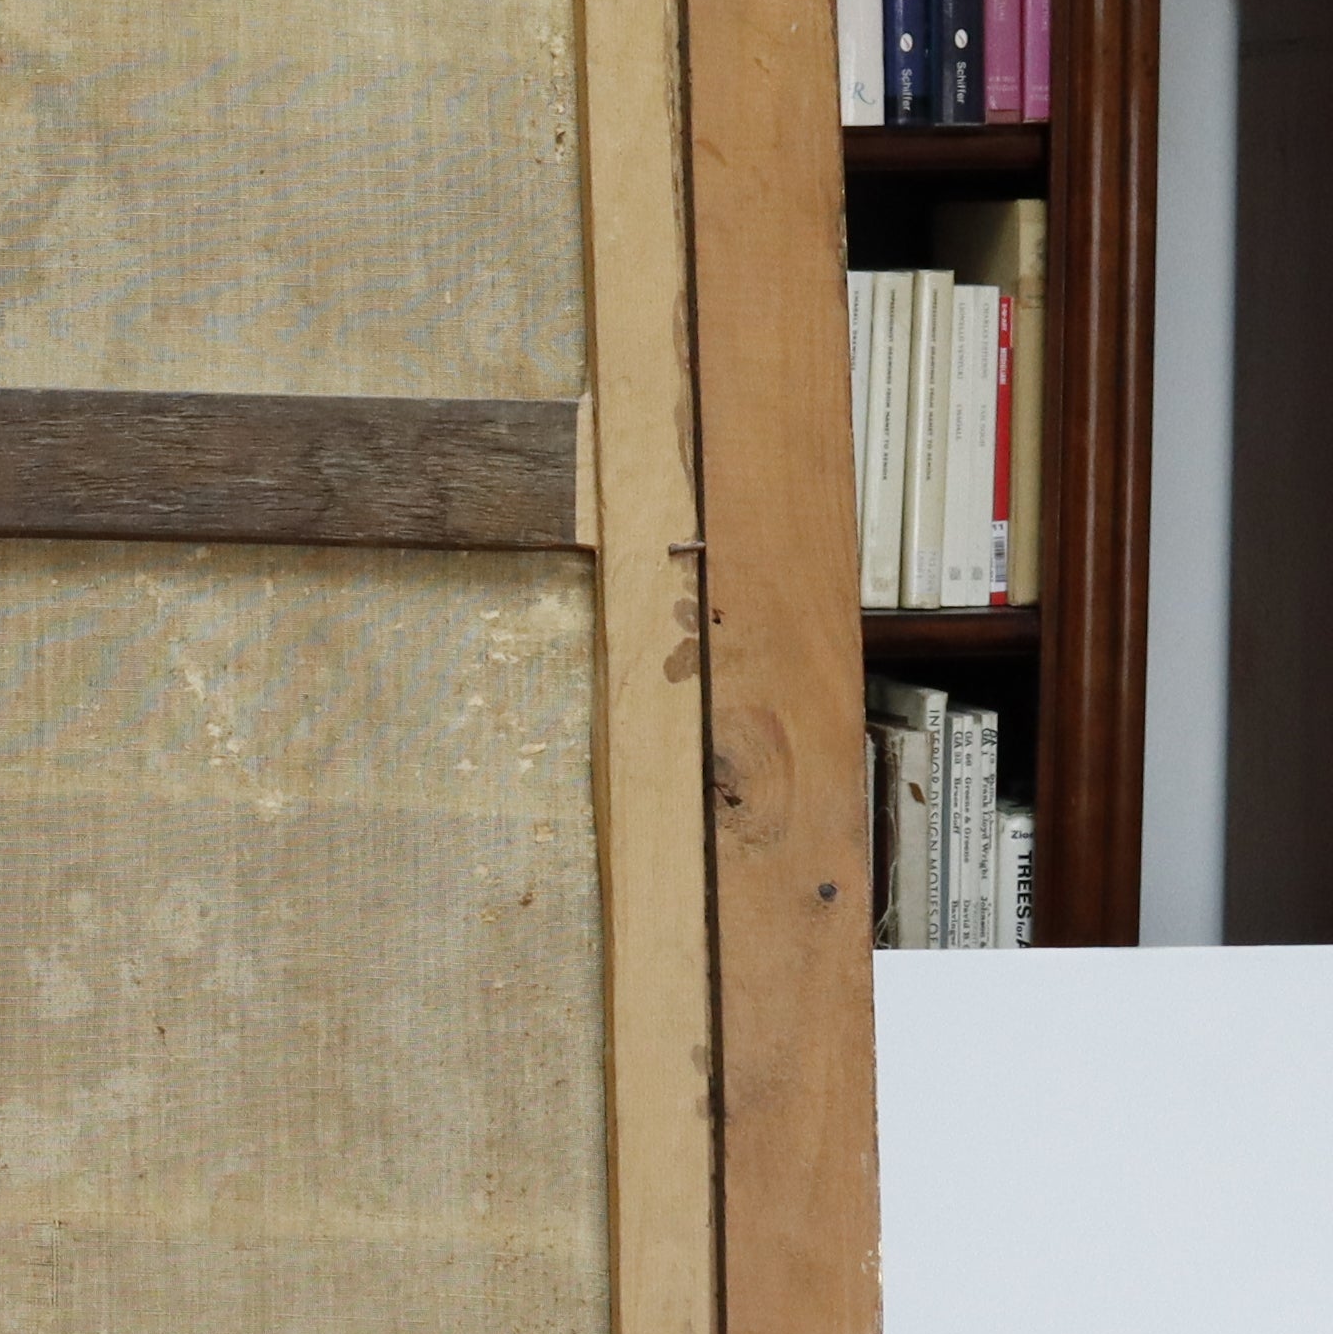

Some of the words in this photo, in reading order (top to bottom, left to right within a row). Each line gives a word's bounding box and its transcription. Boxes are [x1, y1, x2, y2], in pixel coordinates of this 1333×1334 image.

[900, 68, 914, 112] Schiffer
[956, 60, 968, 104] Schiffer
[929, 346, 937, 385] DRAWINGS
[957, 345, 965, 380] VENTURI
[882, 452, 890, 481] RENOIR
[954, 731, 963, 749] GA
[964, 731, 973, 748] GA
[952, 777, 961, 808] Bruce
[964, 777, 973, 814] Greene
[981, 777, 991, 807] Frank
[951, 812, 961, 835] Goff
[980, 810, 991, 840] Lloyd
[963, 827, 972, 864] Greene
[979, 843, 990, 881] Wright
[1016, 850, 1033, 920] TREES
[962, 900, 971, 929] David
[979, 896, 989, 935] Johnson
[1015, 921, 1025, 939] for
